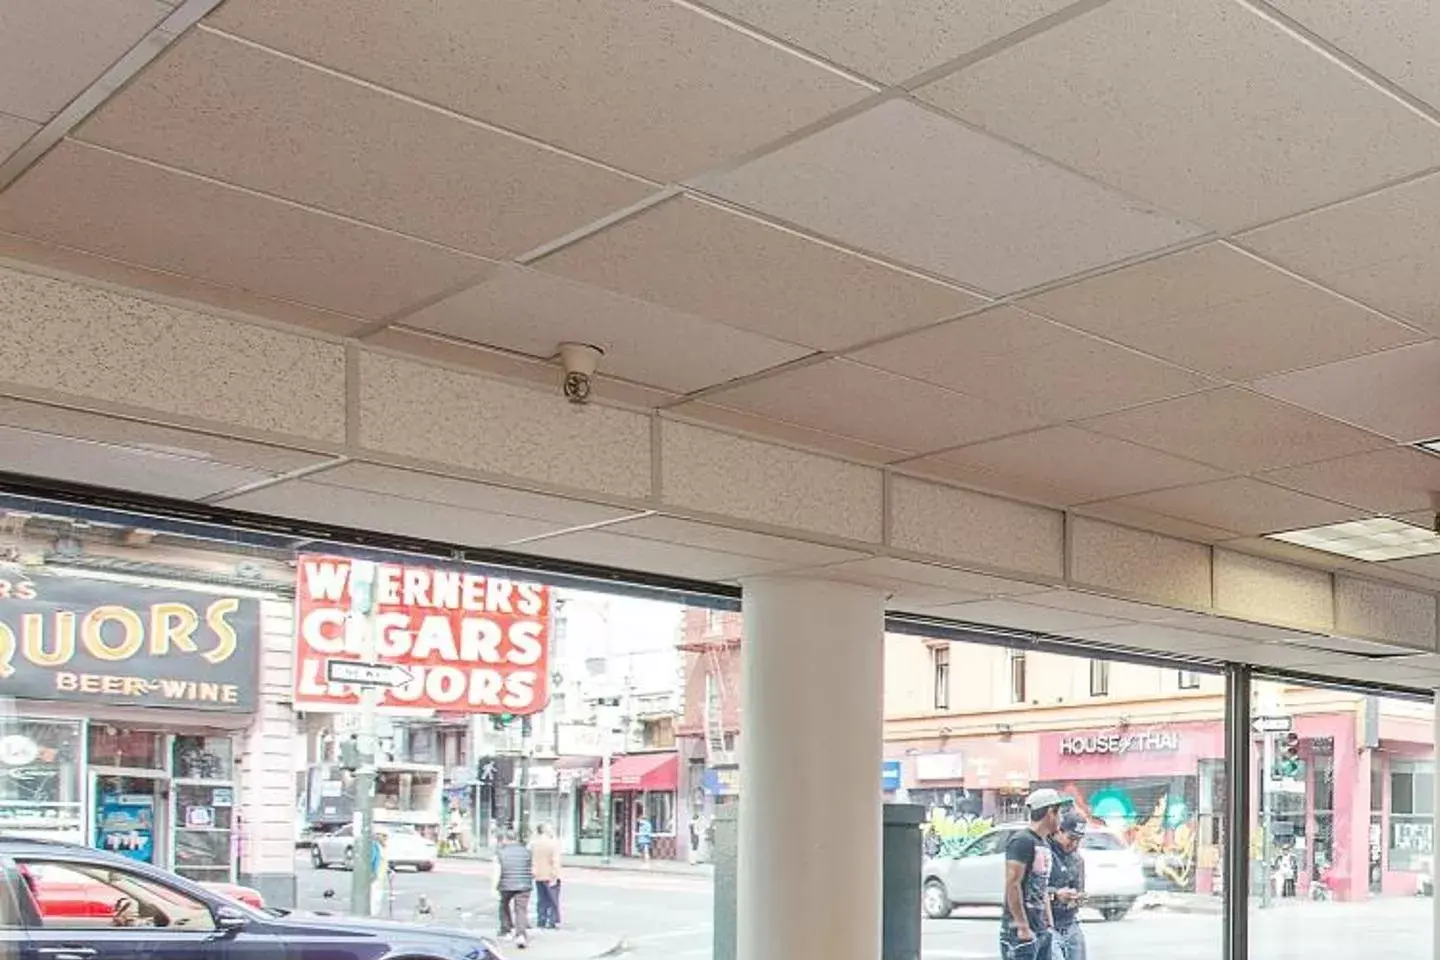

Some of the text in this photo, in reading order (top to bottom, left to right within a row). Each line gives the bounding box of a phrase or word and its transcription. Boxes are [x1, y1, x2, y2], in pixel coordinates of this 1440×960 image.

[0, 599, 239, 679] UORS
[1060, 735, 1120, 755] HOUSE
[1132, 732, 1179, 751] THAI
